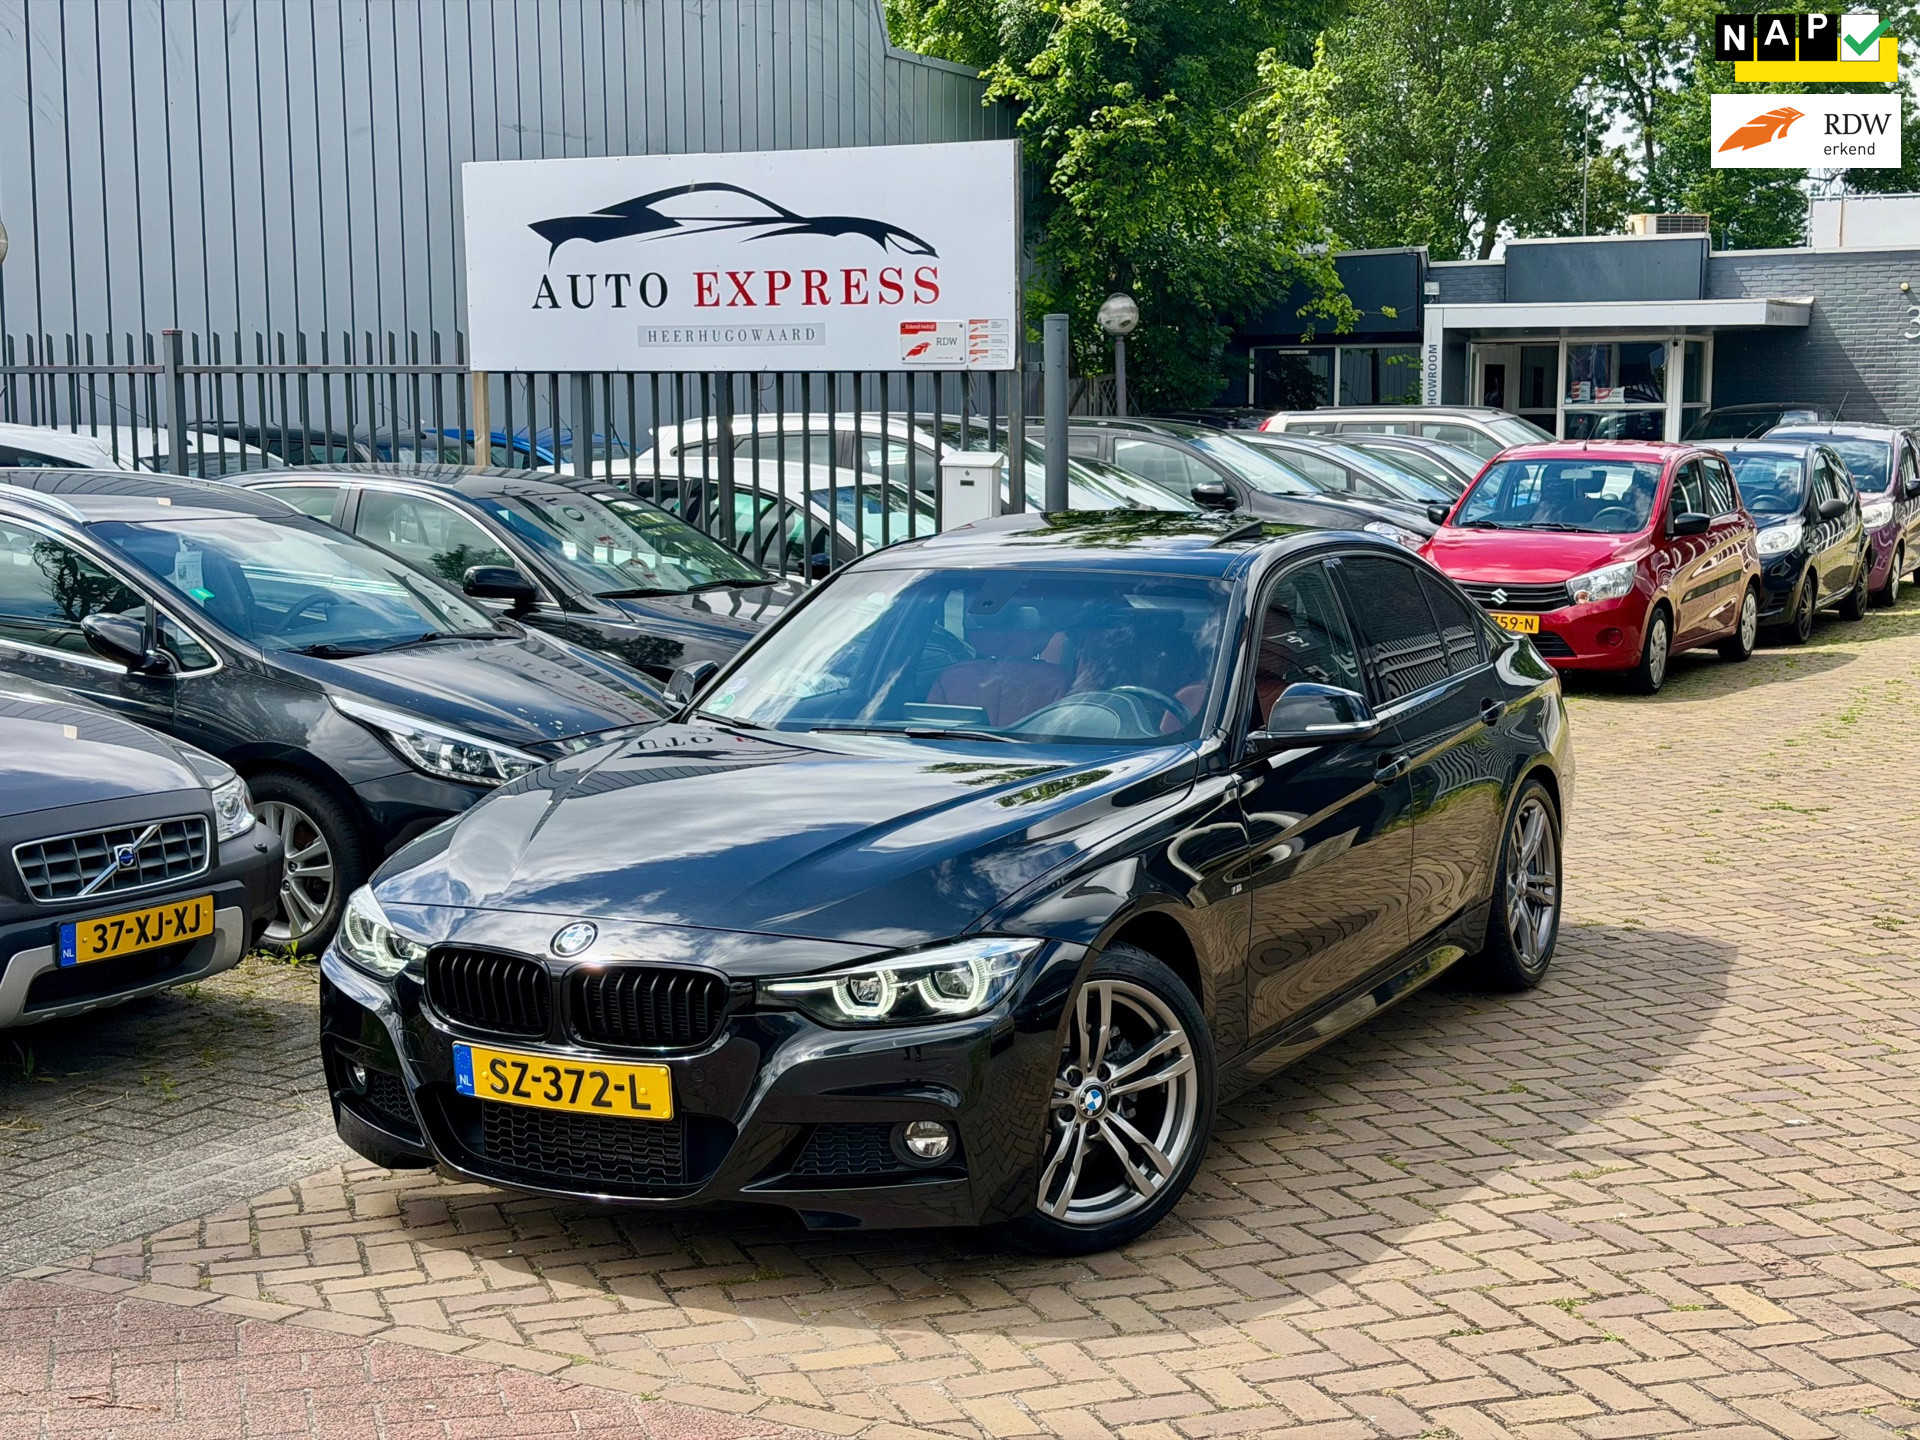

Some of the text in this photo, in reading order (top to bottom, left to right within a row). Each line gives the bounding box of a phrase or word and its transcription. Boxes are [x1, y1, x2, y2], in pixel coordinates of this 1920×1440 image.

[531, 266, 940, 310] AUTO EXPRESS
[647, 327, 816, 343] HEERHUGOWAARD
[936, 337, 957, 346] RDW
[1427, 344, 1437, 405] HOWROOM
[92, 904, 200, 953] 37-XJ-XJ
[62, 949, 75, 958] NL
[459, 1074, 473, 1087] NL
[489, 1057, 652, 1110] SZ-372-L
